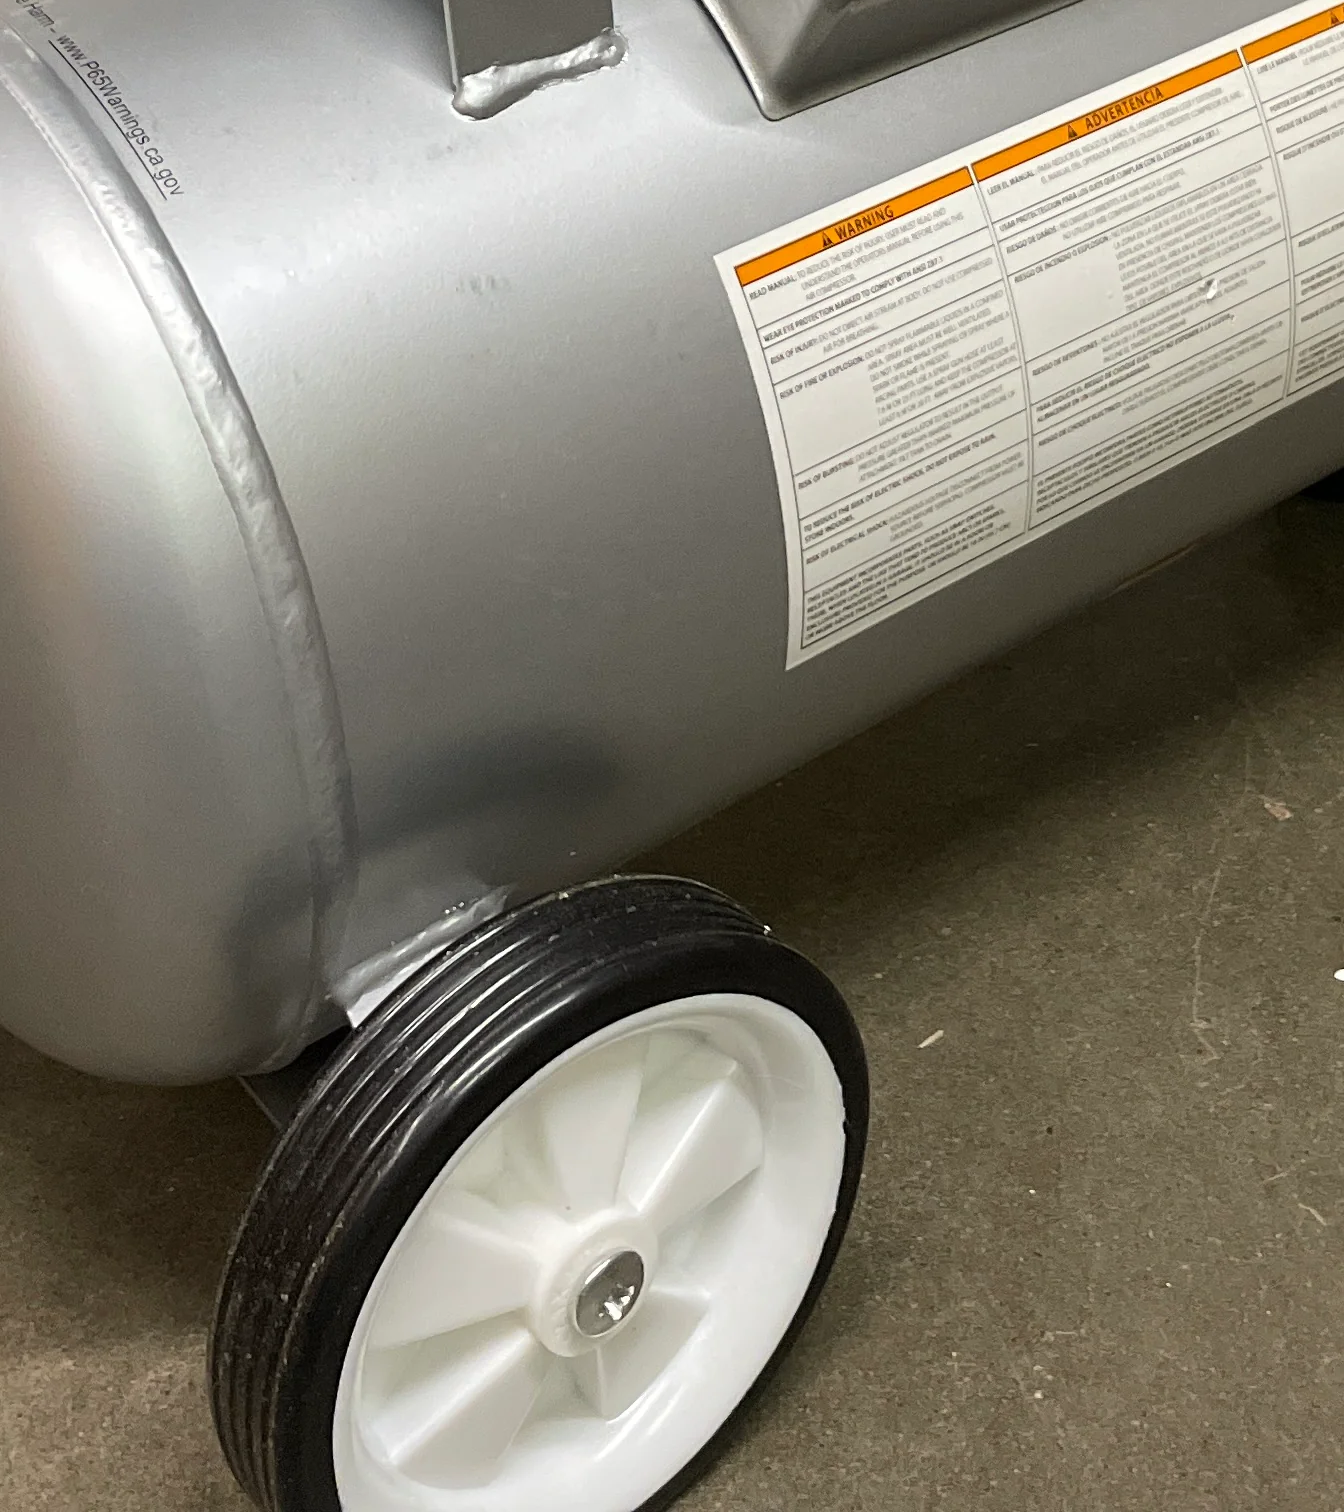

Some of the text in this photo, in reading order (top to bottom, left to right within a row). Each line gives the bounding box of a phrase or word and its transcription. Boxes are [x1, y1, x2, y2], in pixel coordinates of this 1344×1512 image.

[56, 34, 185, 196] www.P65Warnings.ca.gov
[1085, 86, 1164, 131] ADVERTENCIA
[835, 204, 894, 240] WARNING
